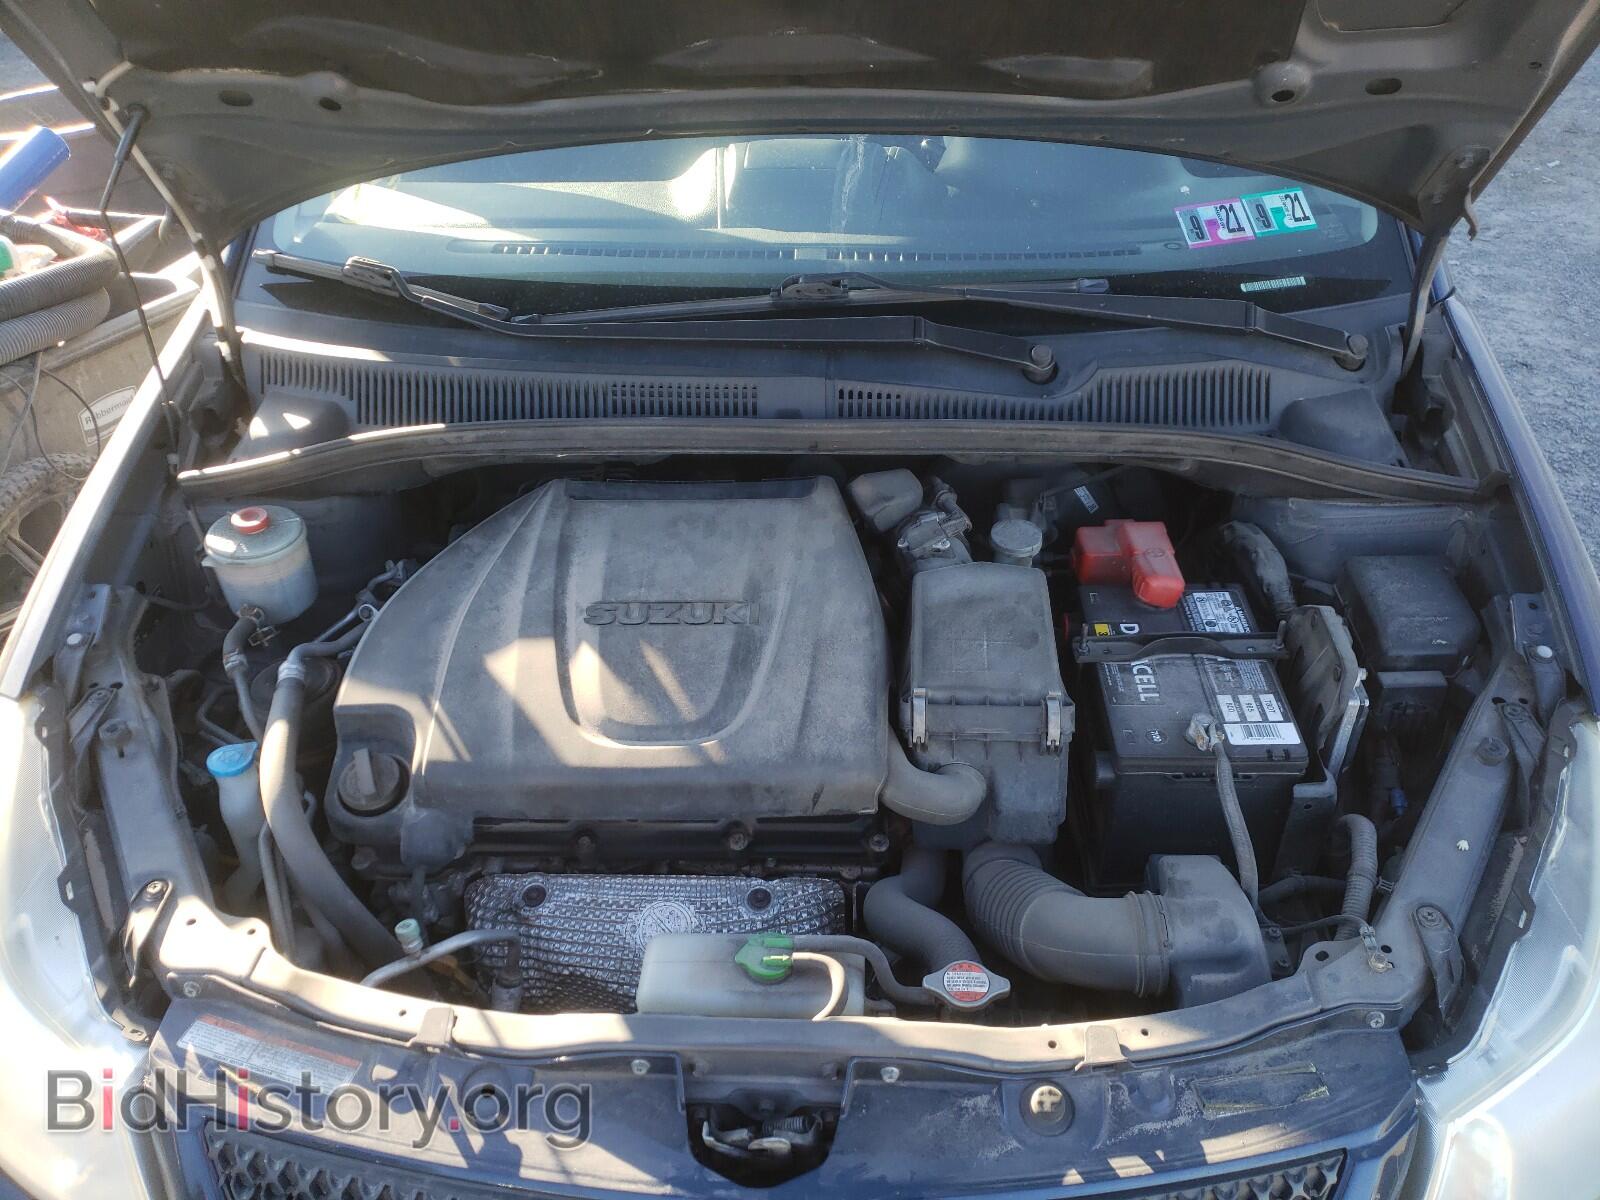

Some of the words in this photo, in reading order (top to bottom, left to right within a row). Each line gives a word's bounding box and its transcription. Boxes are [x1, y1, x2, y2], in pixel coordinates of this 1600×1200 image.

[1190, 215, 1205, 240] 9
[1219, 203, 1246, 233] 21
[1255, 203, 1272, 229] 9
[1284, 192, 1311, 222] 21
[584, 601, 760, 625] SUZUKI
